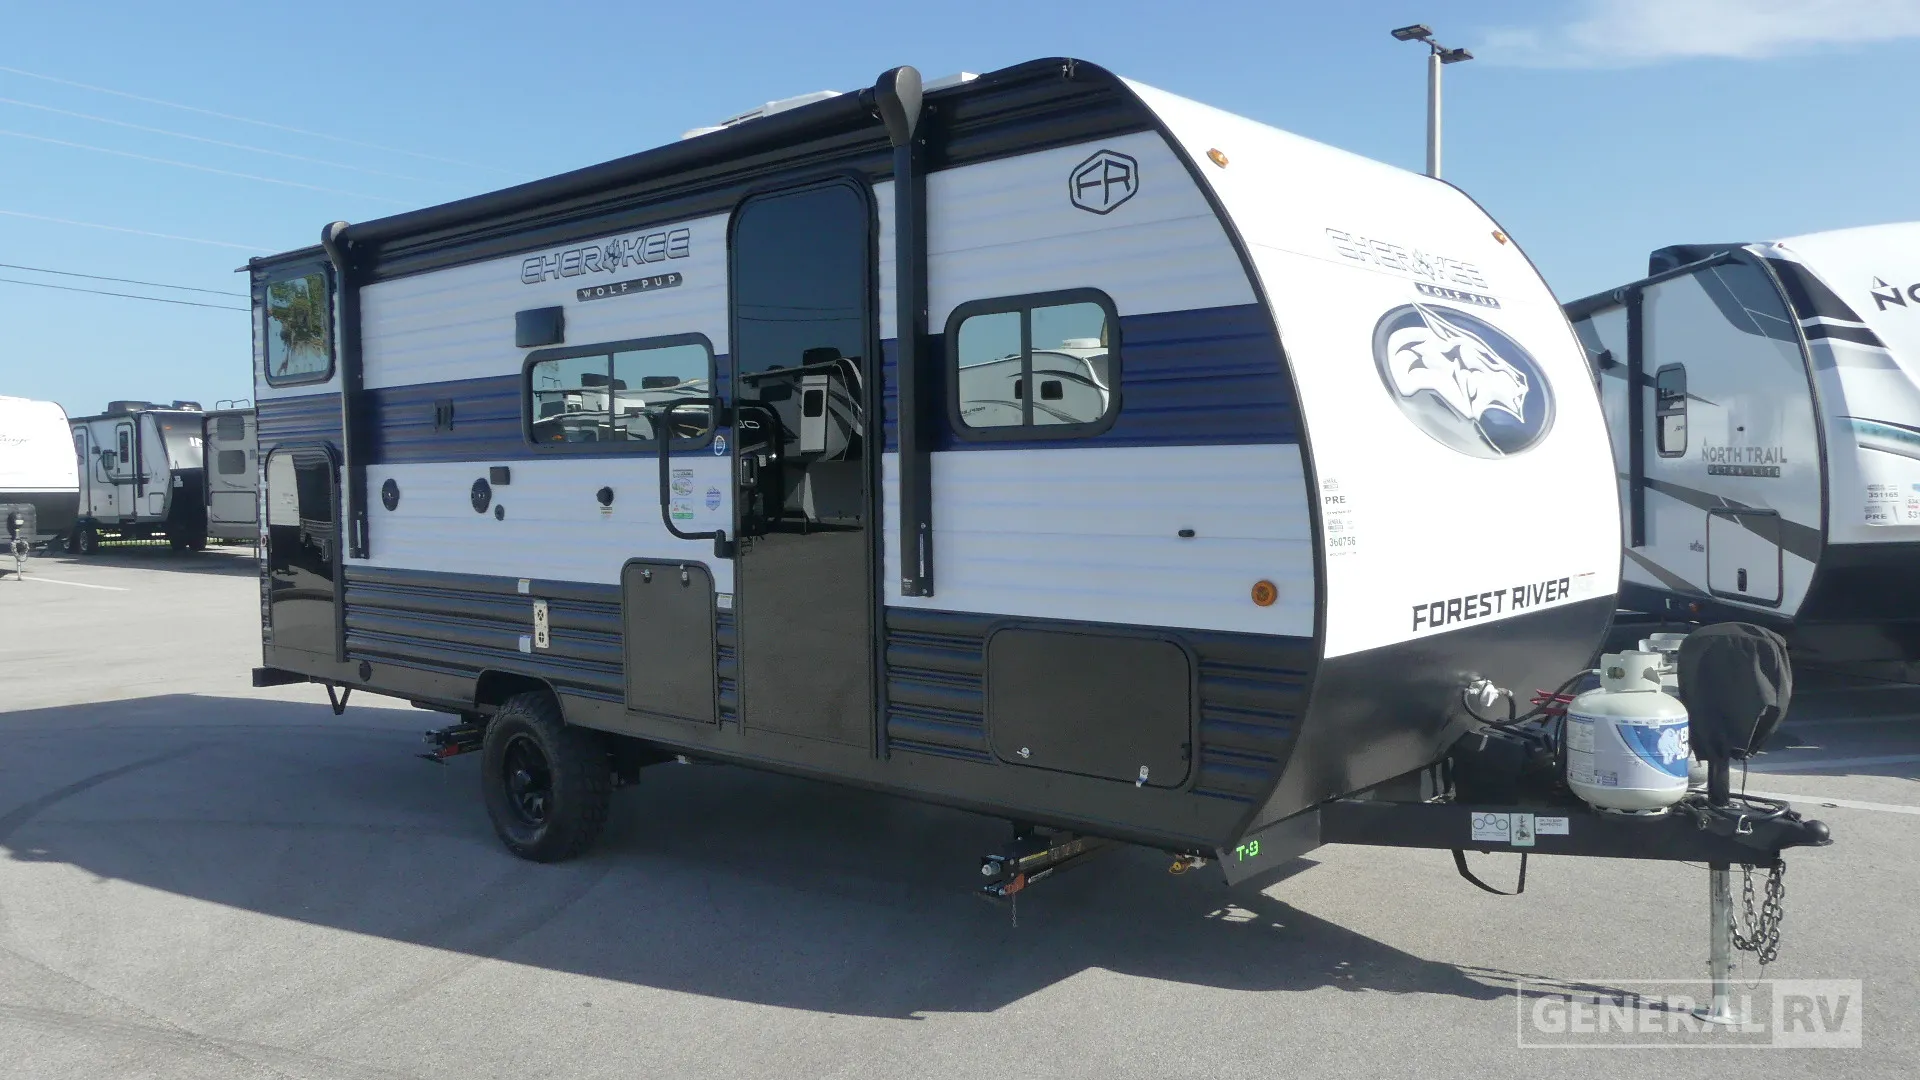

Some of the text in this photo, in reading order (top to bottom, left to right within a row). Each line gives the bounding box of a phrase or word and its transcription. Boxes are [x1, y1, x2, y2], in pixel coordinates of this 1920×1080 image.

[521, 228, 691, 285] CHEROKEE
[582, 275, 676, 298] WOLF PUP
[1420, 284, 1496, 307] WOLF PUP
[1702, 446, 1787, 464] NORTH TRAIL
[1325, 495, 1346, 505] PRE
[1412, 576, 1571, 632] FOREST RIVER
